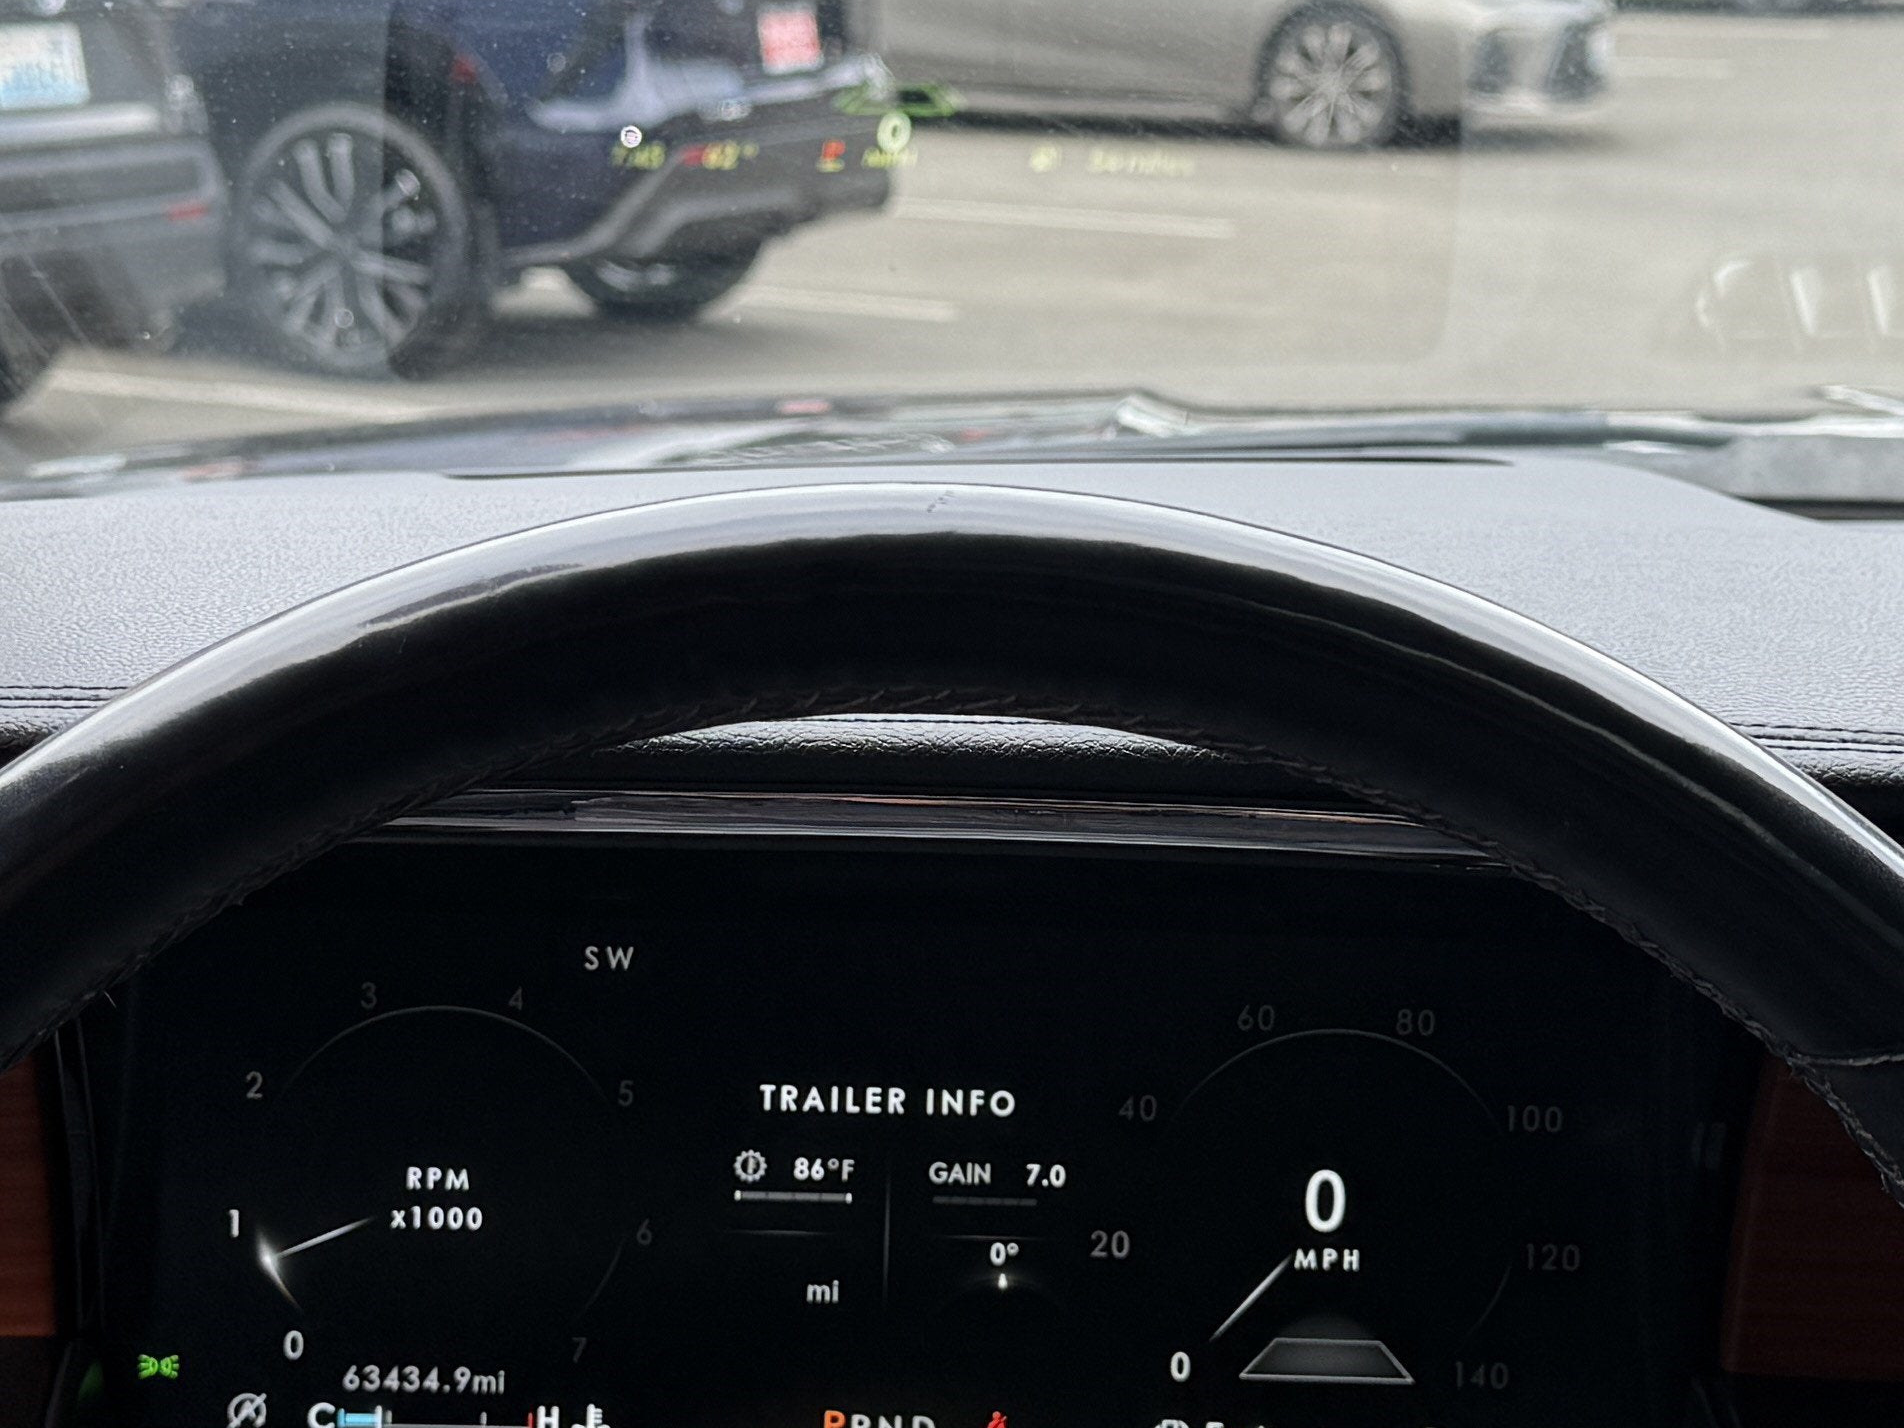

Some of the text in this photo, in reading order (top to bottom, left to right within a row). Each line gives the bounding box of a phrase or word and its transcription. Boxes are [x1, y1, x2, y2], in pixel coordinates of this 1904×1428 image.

[584, 945, 636, 973] SW
[360, 981, 380, 1012] 3
[508, 986, 525, 1012] 4
[1236, 1004, 1278, 1034] 60
[1395, 1008, 1438, 1039] 80
[246, 1071, 265, 1101] 2
[618, 1079, 636, 1109] 5
[759, 1084, 1018, 1119] TRAILER INFO
[1118, 1094, 1160, 1124] 40
[1507, 1104, 1565, 1135] 100
[406, 1166, 472, 1192] RPM
[793, 1156, 857, 1183] 86°F
[928, 1161, 1068, 1190] GAIN 7.0
[1305, 1169, 1348, 1235] 0
[229, 1209, 242, 1240] 1
[390, 1205, 485, 1232] x1000
[636, 1218, 655, 1248] 6
[1090, 1230, 1132, 1260] 20
[1293, 1247, 1362, 1273] MPH
[1526, 1243, 1583, 1274] 120
[806, 1279, 841, 1304] mi
[283, 1330, 306, 1362] 0
[572, 1336, 589, 1366] 7
[1170, 1351, 1193, 1383] 0
[1455, 1360, 1511, 1392] 140
